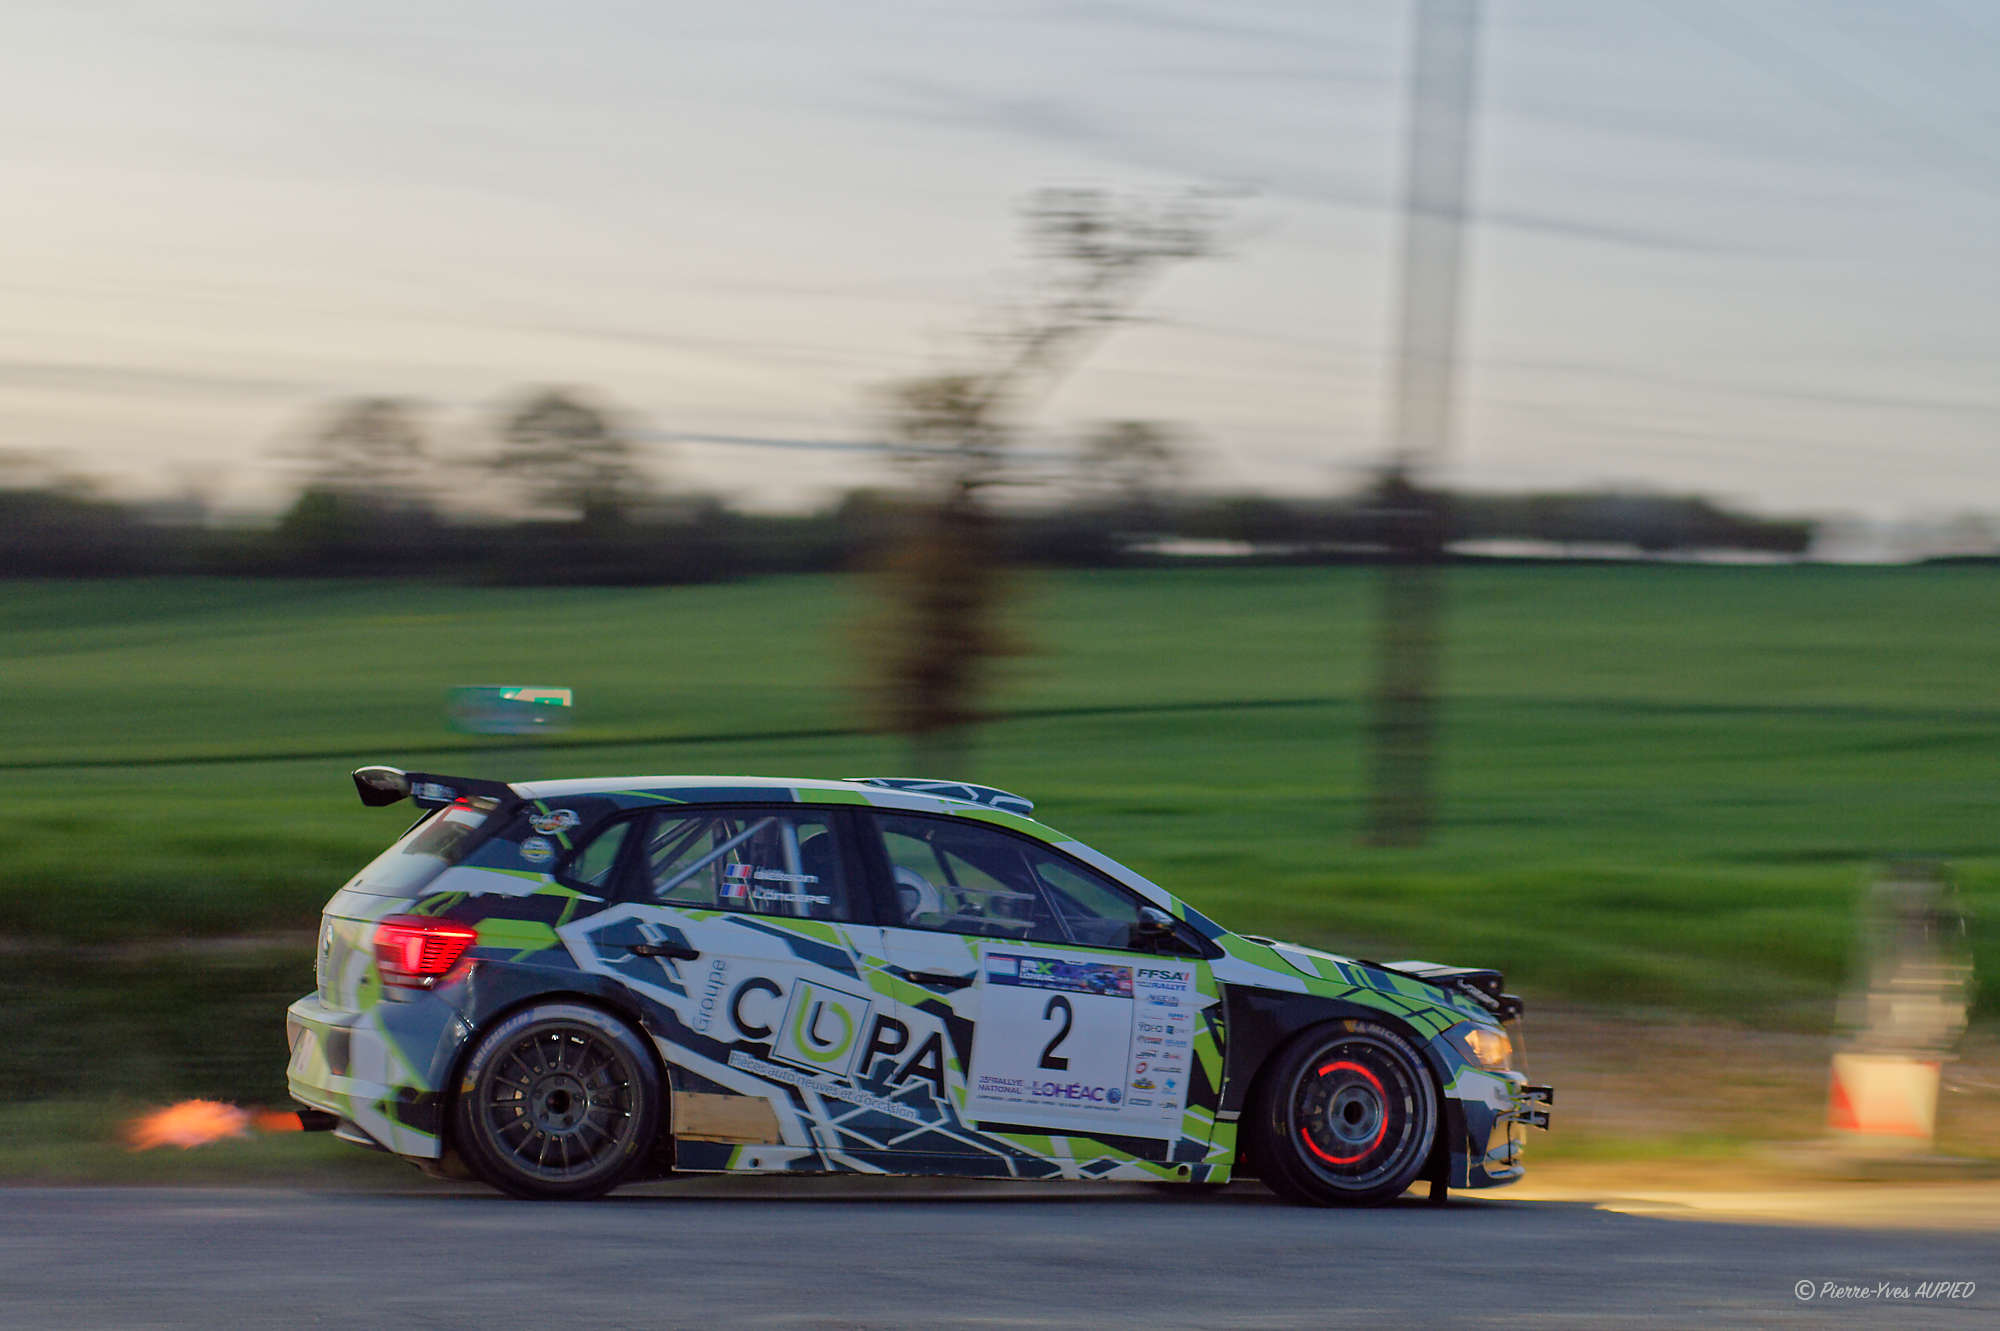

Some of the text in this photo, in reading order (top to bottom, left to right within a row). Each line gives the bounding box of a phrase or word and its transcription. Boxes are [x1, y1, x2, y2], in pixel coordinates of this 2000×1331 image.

[1138, 968, 1184, 981] FFSA
[692, 960, 727, 1032] Groupe
[1039, 995, 1074, 1071] 2
[978, 1084, 1022, 1094] NATIONAL
[1031, 1080, 1104, 1101] LOHÉAC
